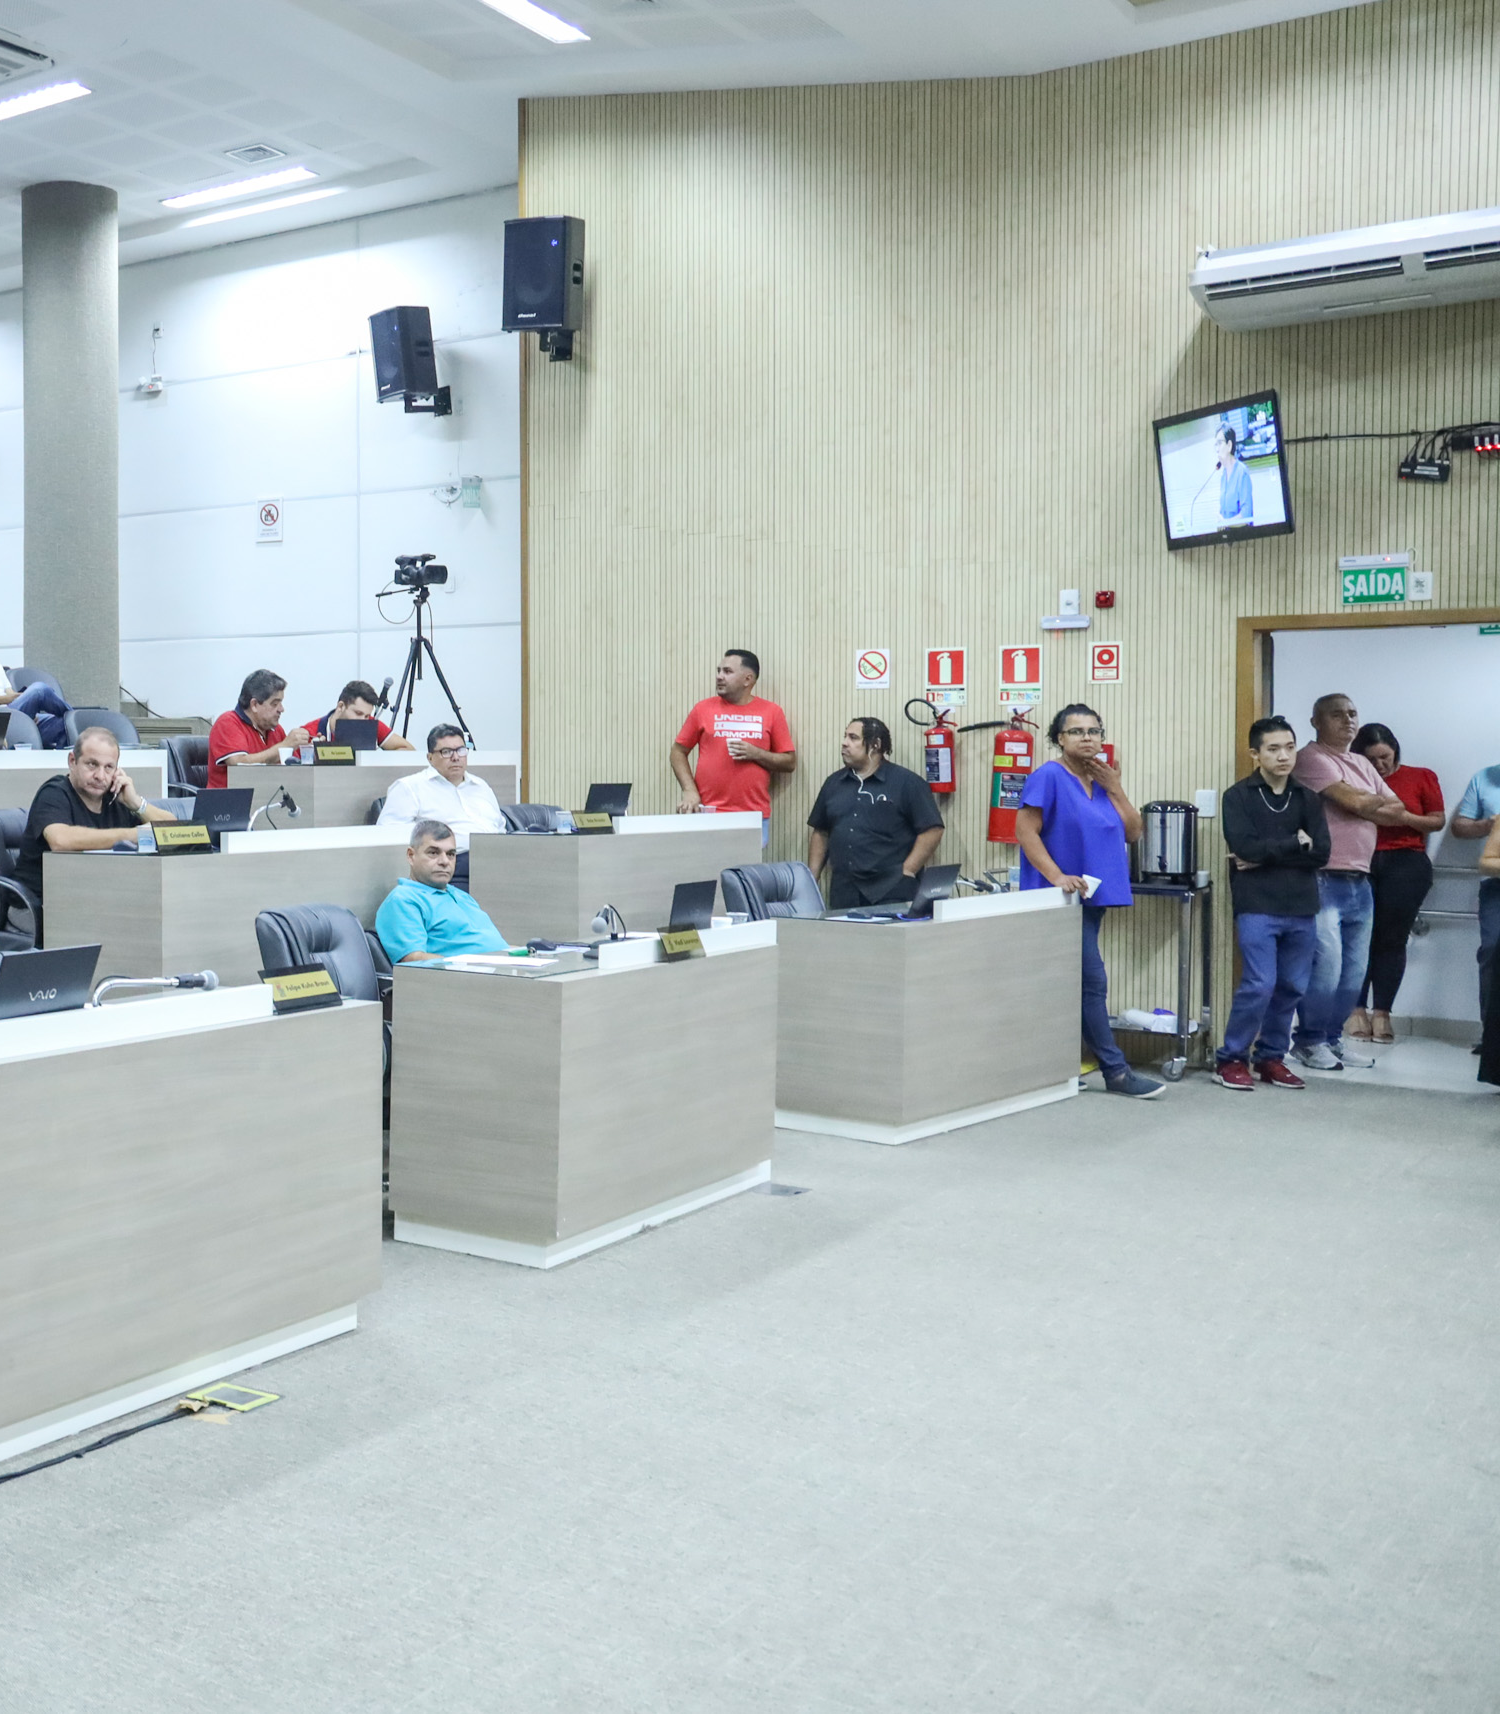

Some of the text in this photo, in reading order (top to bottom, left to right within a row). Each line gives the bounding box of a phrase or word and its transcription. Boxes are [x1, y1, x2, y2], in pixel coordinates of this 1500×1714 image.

[1343, 569, 1404, 597] SAÍDA
[714, 714, 763, 723] UNDER
[713, 730, 763, 740] ARMOUR
[214, 814, 231, 822] VAIO
[28, 987, 58, 1002] VAIO
